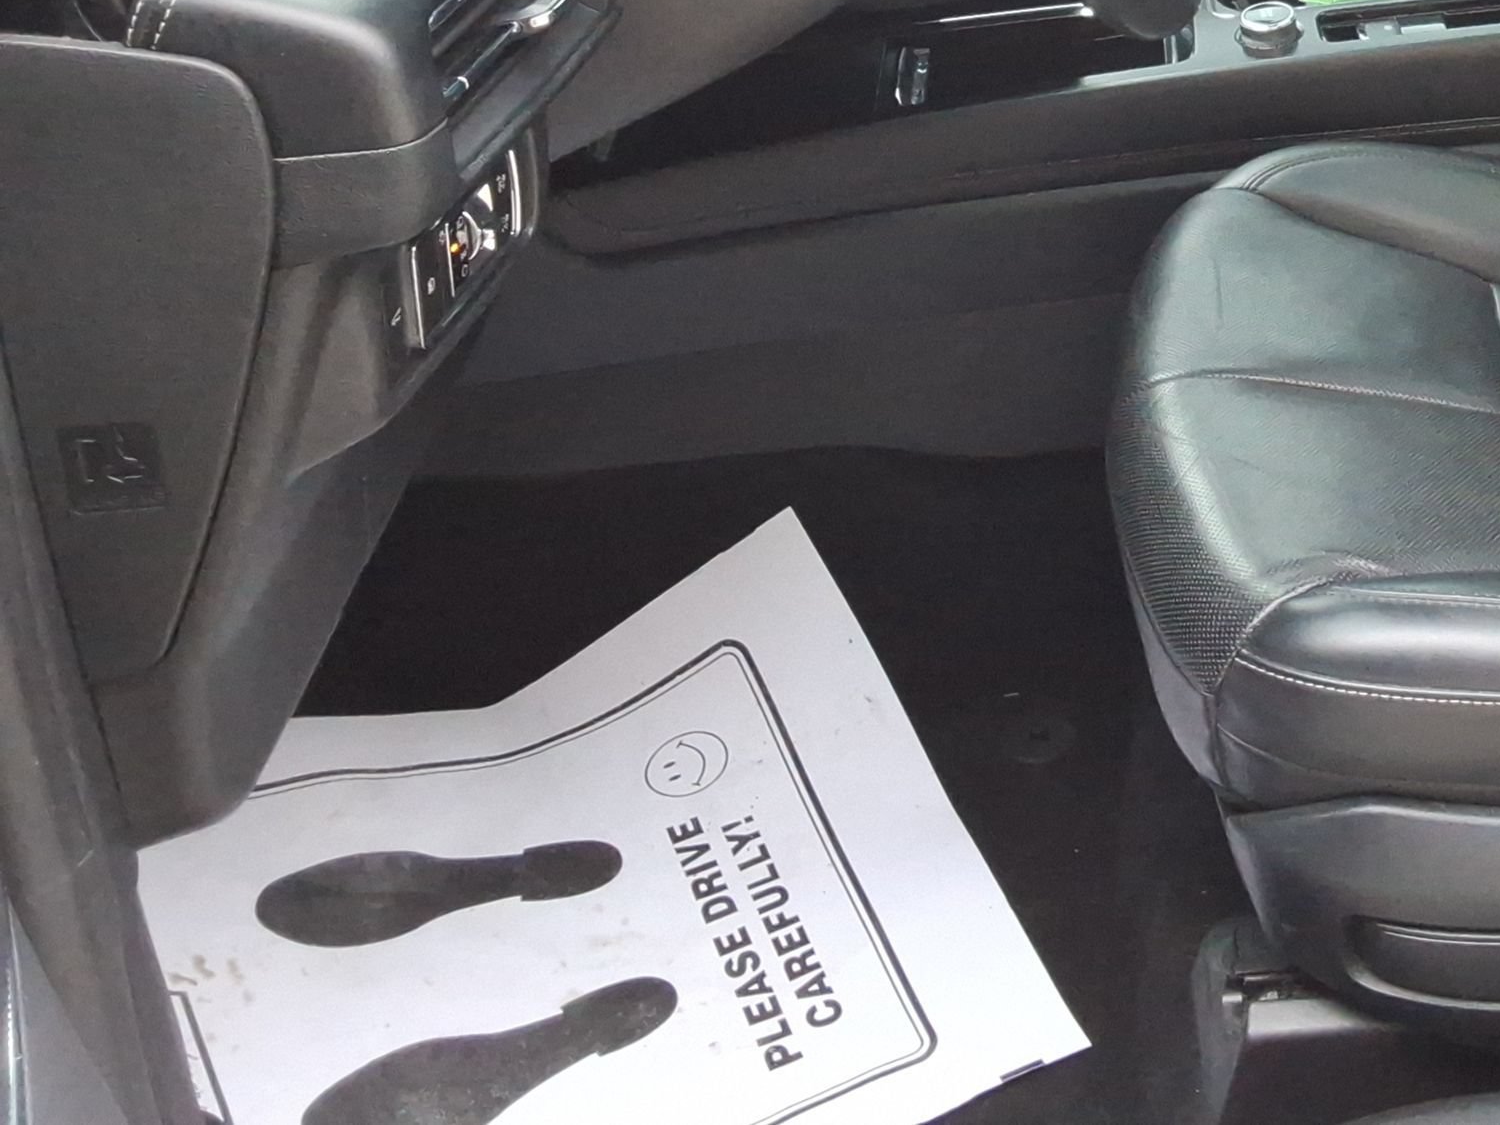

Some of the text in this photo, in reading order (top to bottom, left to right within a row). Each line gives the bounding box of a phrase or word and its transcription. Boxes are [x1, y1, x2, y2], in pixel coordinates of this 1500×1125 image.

[666, 816, 803, 1071] PLEASE DRIVE
[720, 815, 843, 1028] CAREFULLY!
